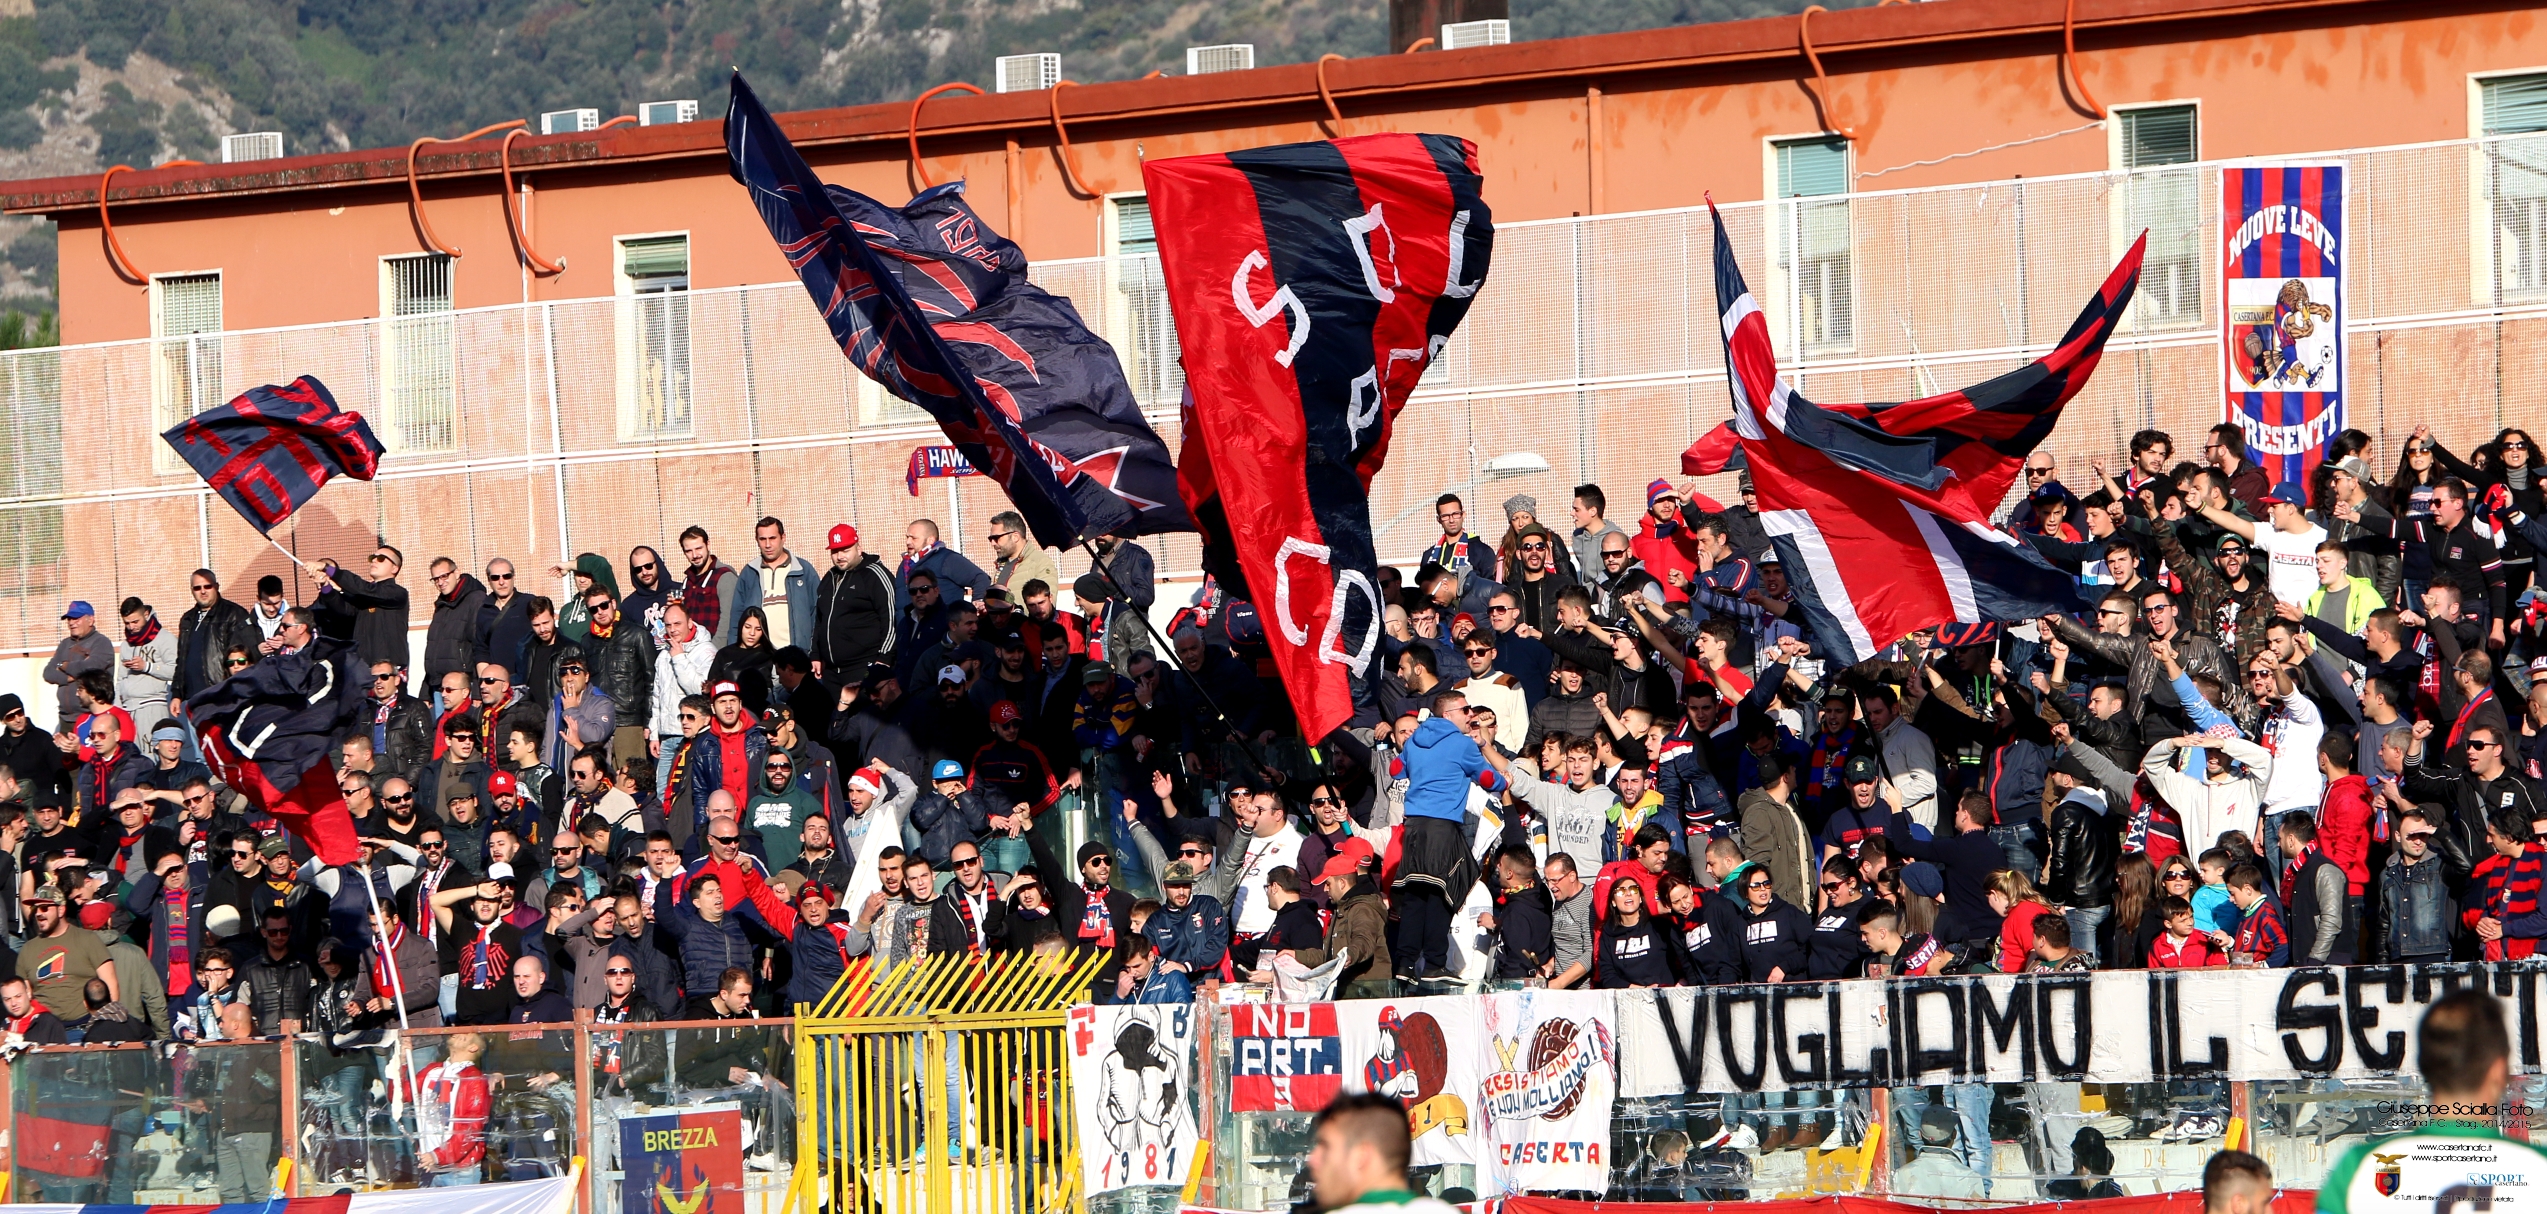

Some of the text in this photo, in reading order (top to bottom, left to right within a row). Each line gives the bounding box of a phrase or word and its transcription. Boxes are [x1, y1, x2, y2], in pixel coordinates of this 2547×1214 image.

[2228, 204, 2336, 268] NUOVE LEVE
[2233, 309, 2265, 323] CASERTANA
[2231, 399, 2337, 456] PRESENTI
[1252, 1003, 1311, 1038] NO
[1650, 969, 2093, 1093] VOGLIAMO
[2147, 970, 2229, 1082] IL
[1241, 1037, 1334, 1077] ART.
[1484, 1041, 1580, 1099] RESISTIAMO
[1497, 1090, 1521, 1116] NON
[643, 1126, 718, 1153] BREZZA
[1499, 1141, 1601, 1166] CASERTA
[1101, 1143, 1177, 1189] 1981
